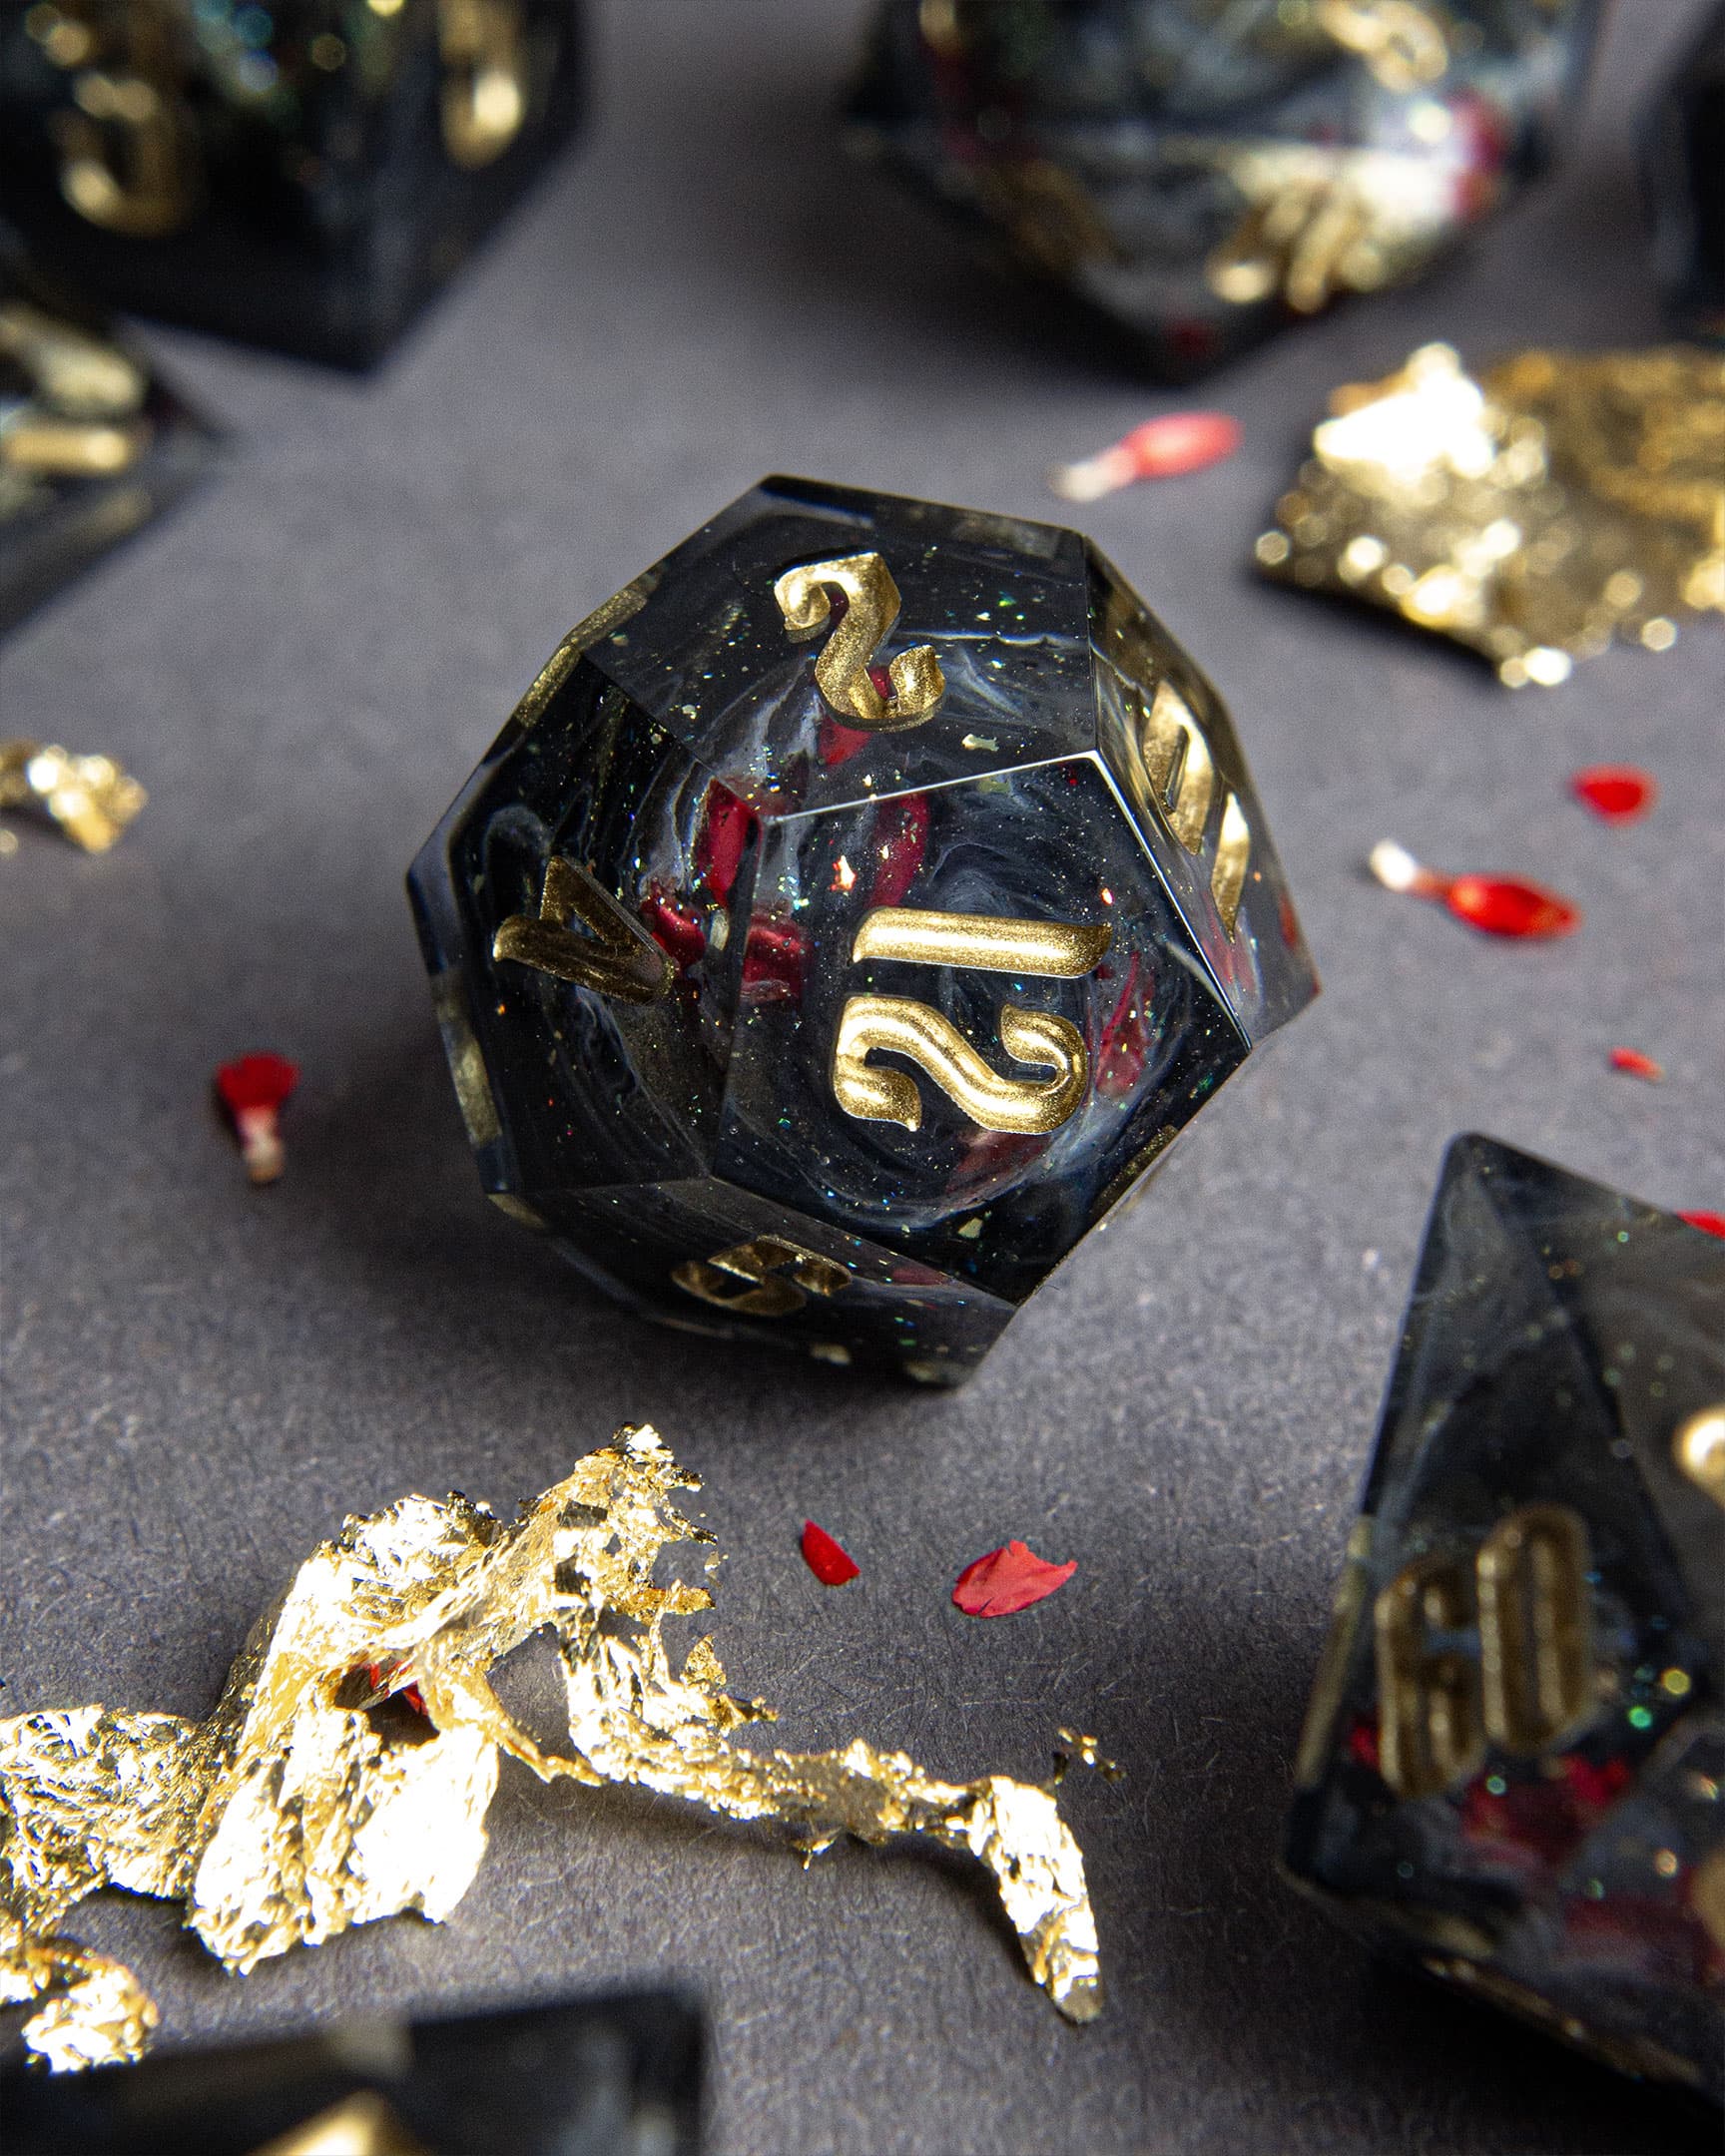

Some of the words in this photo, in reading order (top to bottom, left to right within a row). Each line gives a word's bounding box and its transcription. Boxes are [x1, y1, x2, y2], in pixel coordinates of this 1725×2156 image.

[774, 550, 945, 733] 2
[493, 854, 678, 998] 4
[831, 906, 1112, 1136] 12
[1374, 1502, 1591, 1799] 60
